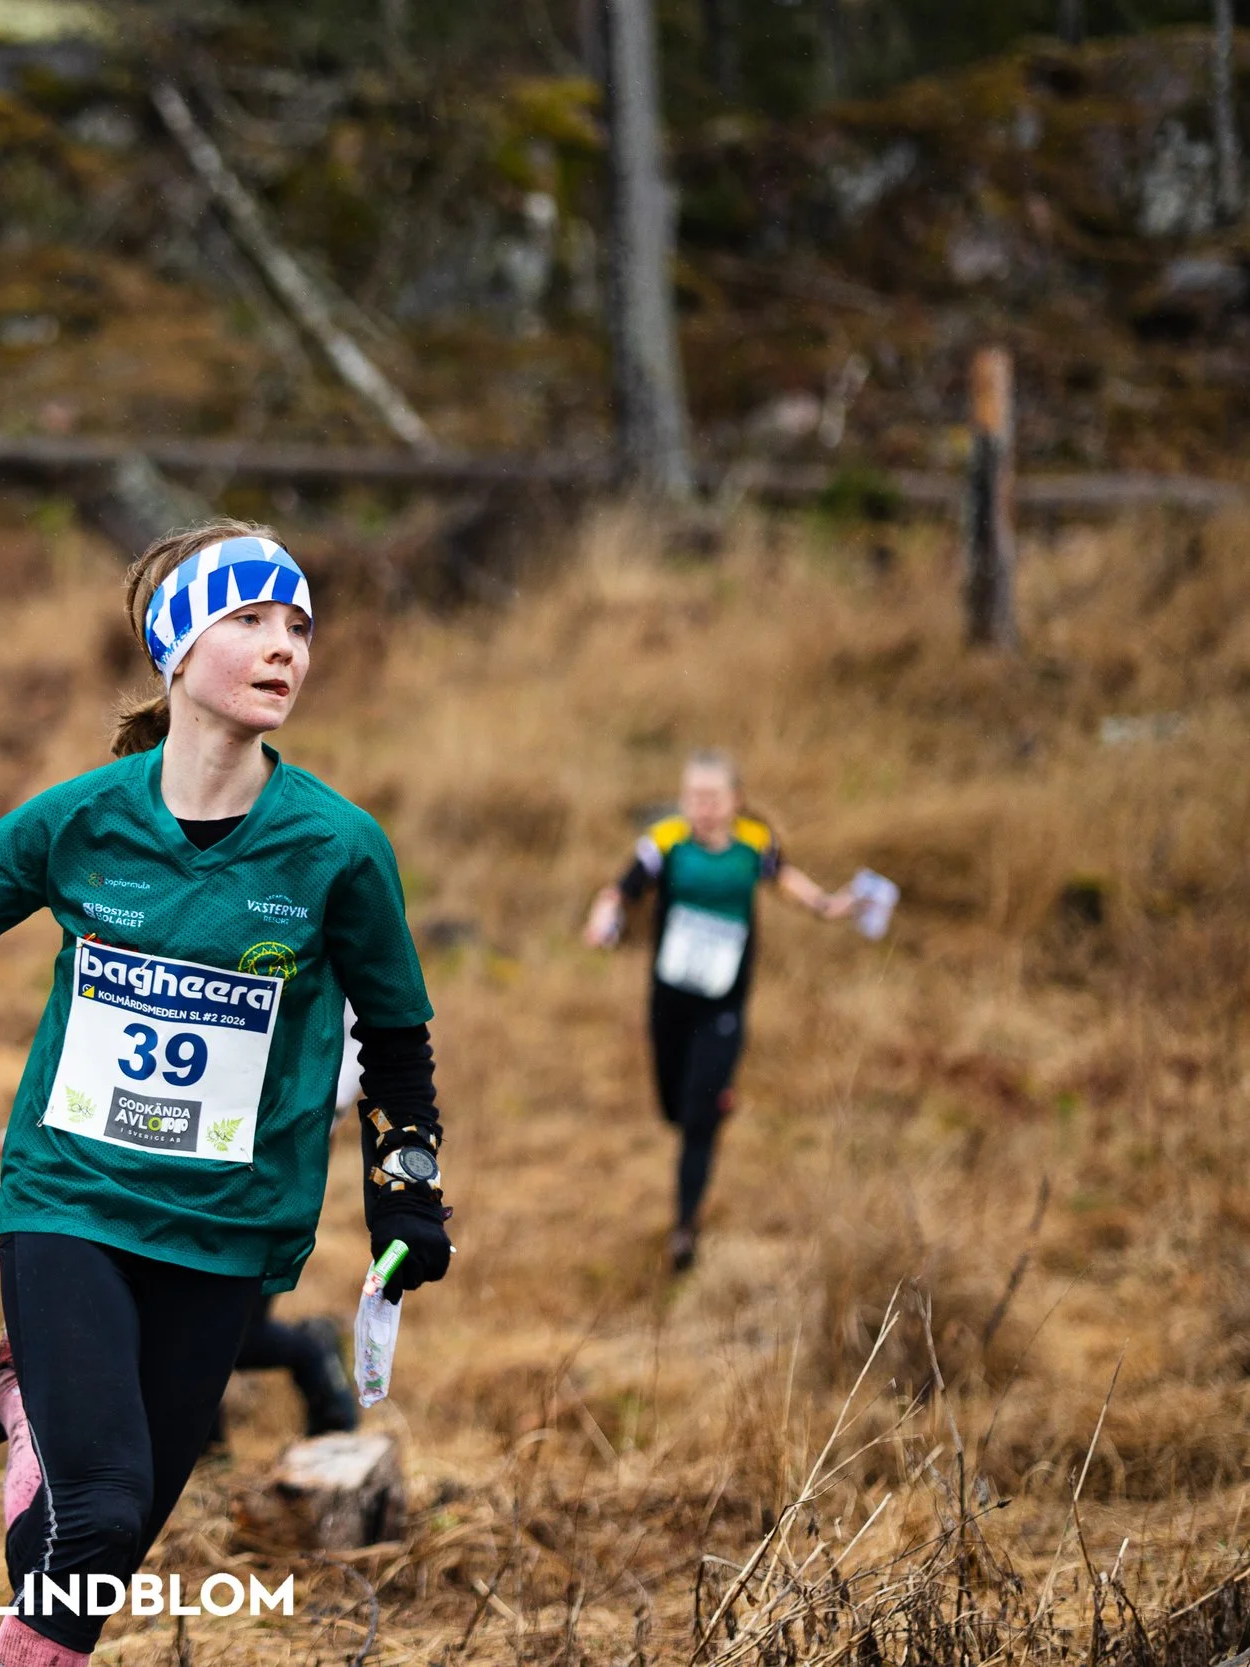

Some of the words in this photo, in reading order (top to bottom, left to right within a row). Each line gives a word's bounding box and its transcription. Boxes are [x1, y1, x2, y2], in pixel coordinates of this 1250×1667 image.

[95, 903, 145, 919] BOSTADS
[247, 899, 309, 918] VÄSTERVIK
[81, 948, 273, 1011] bagheera
[97, 990, 187, 1019] KOLMÅRDSMEDELN
[190, 1011, 201, 1020] SL
[203, 1012, 218, 1022] #2
[220, 1014, 246, 1026] 2026
[117, 1022, 209, 1087] 39
[118, 1096, 191, 1119] GODKÄNDA
[128, 1129, 166, 1142] SVERIGE
